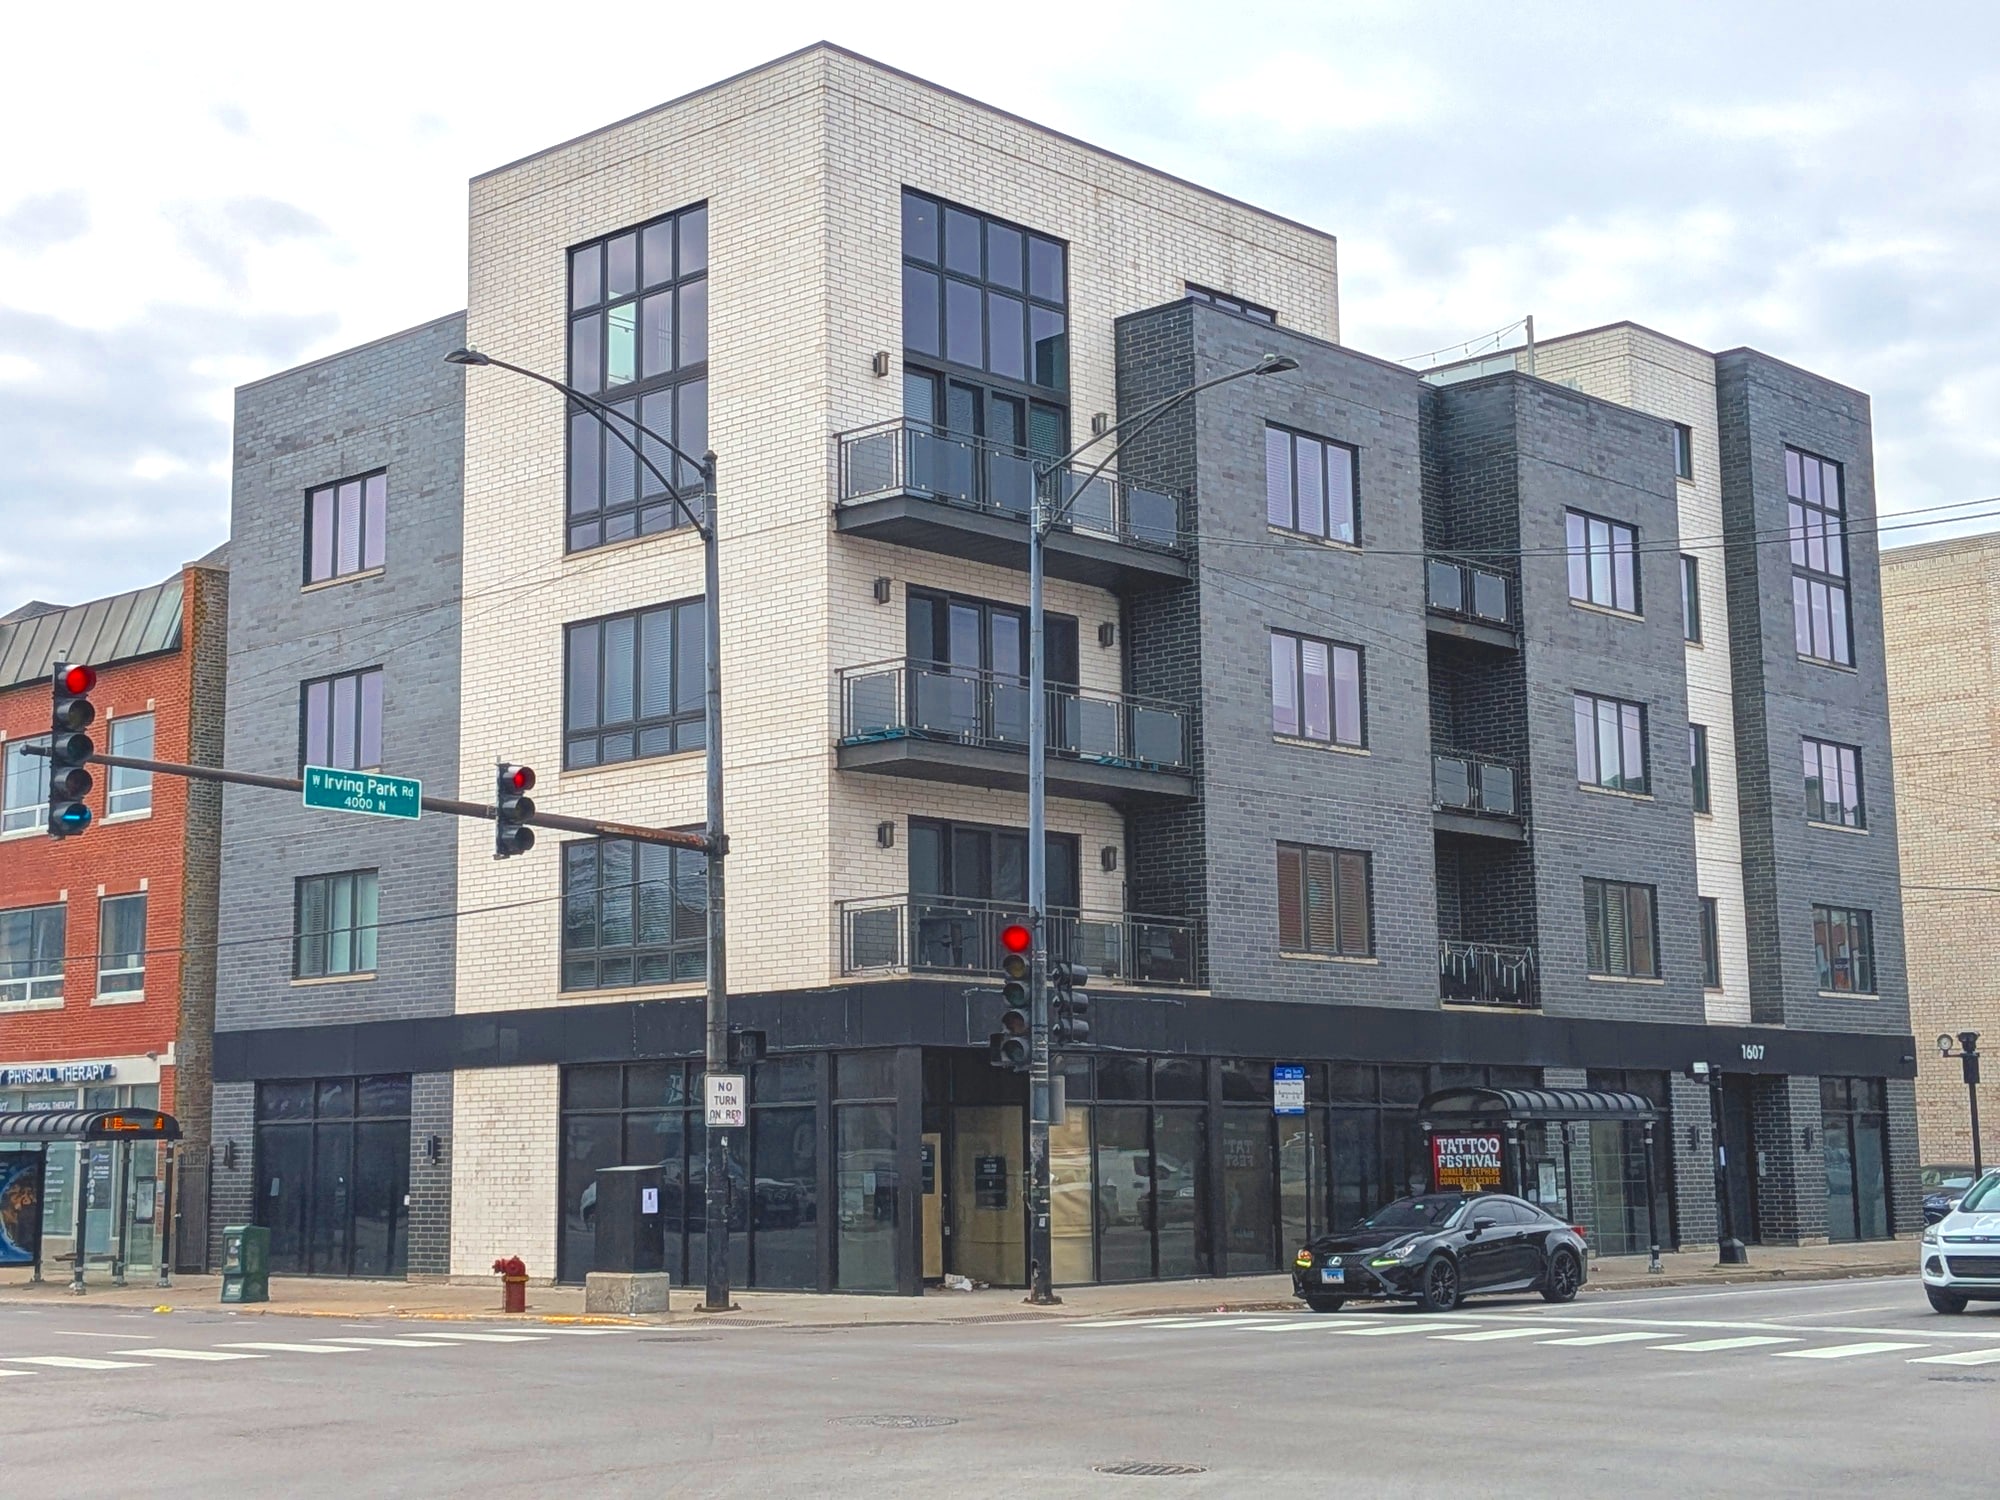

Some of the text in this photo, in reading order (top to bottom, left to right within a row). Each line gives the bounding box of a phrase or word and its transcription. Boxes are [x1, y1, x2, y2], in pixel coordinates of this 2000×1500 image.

[312, 773, 414, 797] W Irving Park Rd
[344, 796, 386, 811] 4000 N
[1741, 1044, 1764, 1060] 1607
[8, 1068, 54, 1084] PHYSICAL
[60, 1064, 106, 1082] THERAPY
[718, 1082, 733, 1092] NO
[28, 1101, 75, 1111] PHYSICAL THERAPY
[714, 1096, 737, 1105] TURN
[710, 1109, 742, 1120] ON RED
[1436, 1138, 1500, 1154] TATTOO
[1437, 1154, 1501, 1168] FESTIVAL
[1440, 1168, 1462, 1176] DONALD
[1471, 1168, 1500, 1176] STEPHENS
